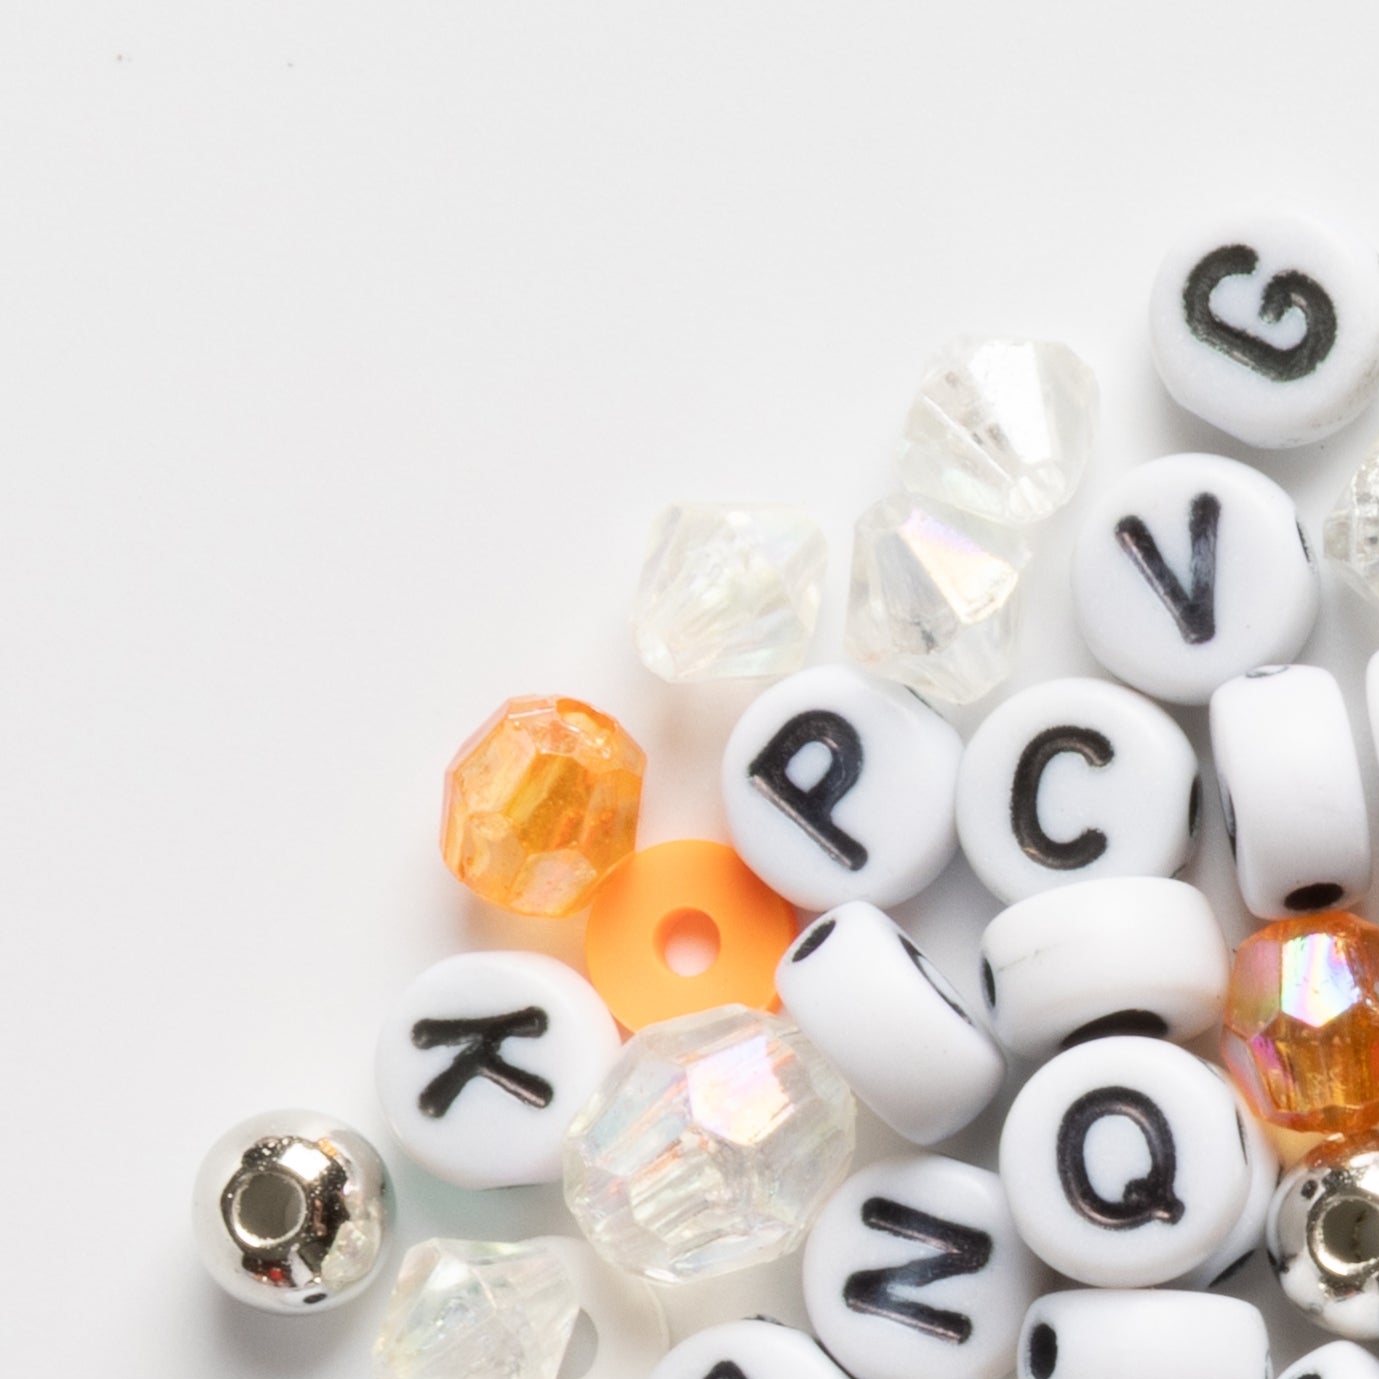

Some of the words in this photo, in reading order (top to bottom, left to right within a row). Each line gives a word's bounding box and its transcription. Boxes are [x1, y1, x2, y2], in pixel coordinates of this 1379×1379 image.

[1182, 244, 1337, 382] G
[1115, 492, 1221, 644] V
[748, 710, 868, 871] P
[1009, 725, 1115, 871] C
[411, 1006, 554, 1119] K
[1056, 1086, 1186, 1231] Q
[842, 1196, 994, 1345] N
